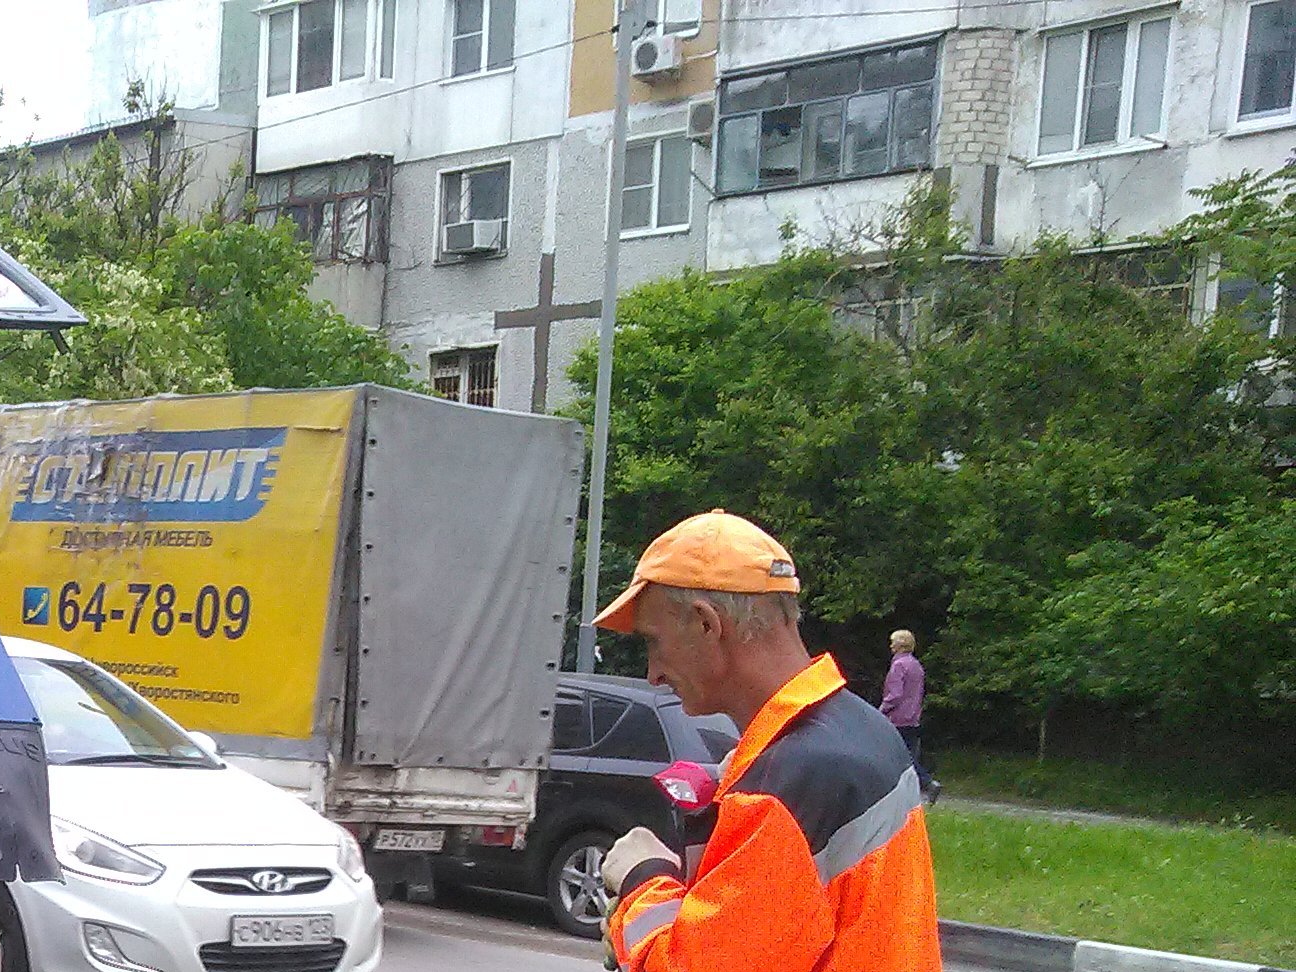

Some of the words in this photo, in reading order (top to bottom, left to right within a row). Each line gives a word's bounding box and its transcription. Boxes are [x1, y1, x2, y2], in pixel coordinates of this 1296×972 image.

[31, 448, 269, 503] СТЛПЛИТ
[154, 530, 214, 549] МЕБЕЛЬ
[58, 581, 251, 640] 64-78-09
[90, 656, 179, 677] вороссийск
